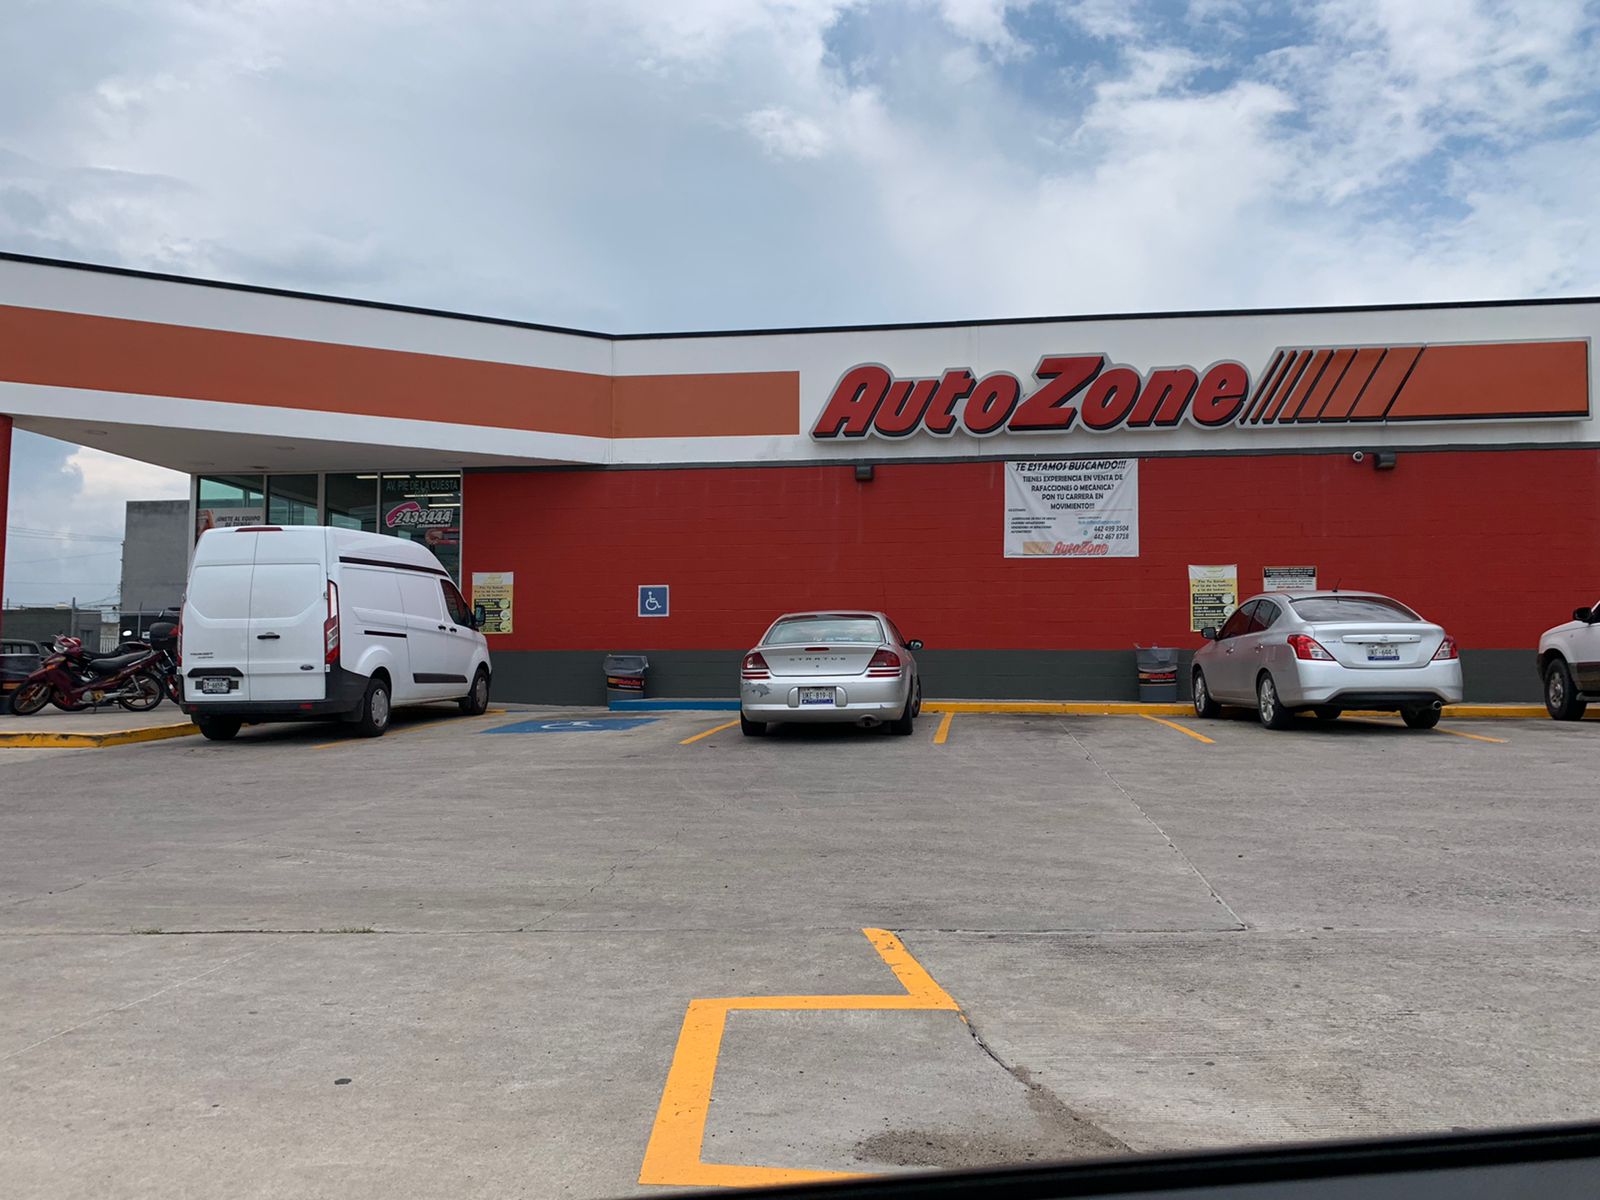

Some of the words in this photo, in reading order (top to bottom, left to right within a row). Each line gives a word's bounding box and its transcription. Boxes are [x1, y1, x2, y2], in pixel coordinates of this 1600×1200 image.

[812, 355, 1252, 438] AutoZone
[1016, 463, 1025, 471] TE
[1027, 462, 1066, 471] ESTAMOS
[1068, 460, 1126, 471] BUSCANDO!!!
[394, 510, 452, 524] 2433444
[1053, 541, 1109, 555] AutoZone
